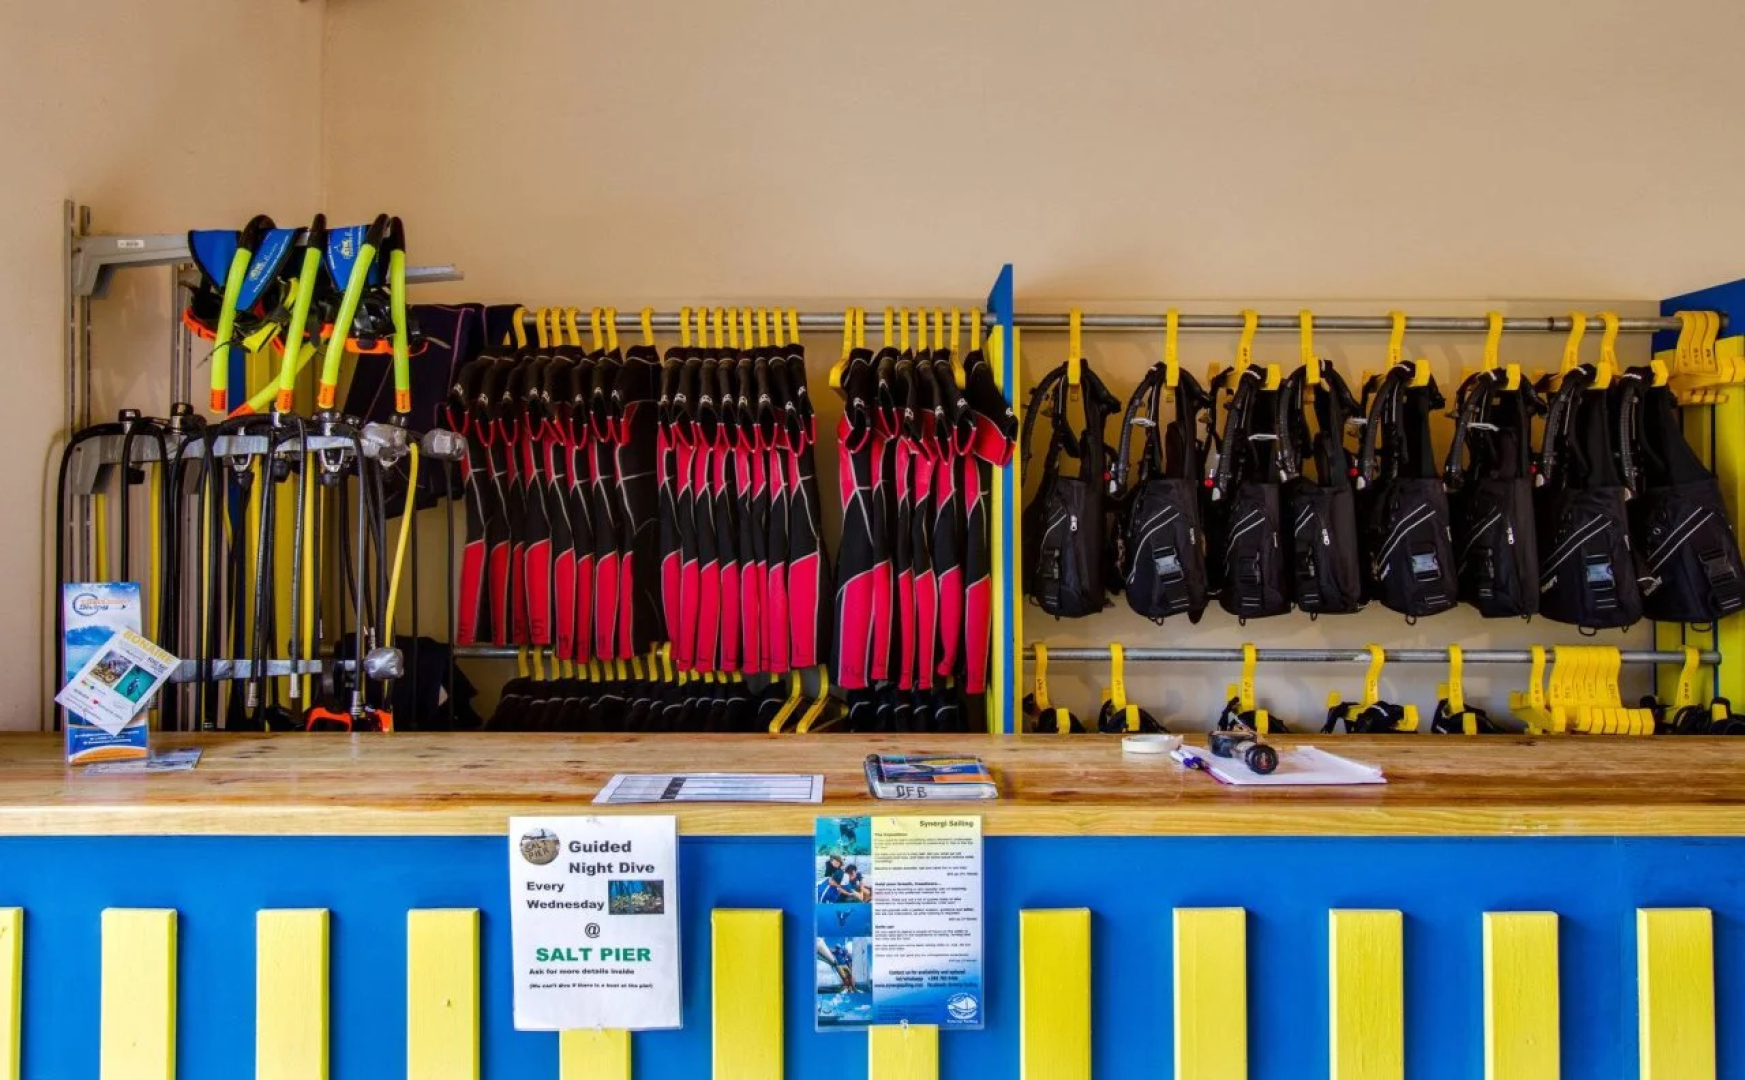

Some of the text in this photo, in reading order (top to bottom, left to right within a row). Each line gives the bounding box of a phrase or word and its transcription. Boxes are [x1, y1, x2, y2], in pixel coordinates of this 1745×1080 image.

[919, 820, 974, 828] Synergi Sailing
[525, 840, 547, 853] SALT
[569, 840, 632, 853] Guided
[569, 862, 655, 876] Night Dive
[526, 881, 565, 893] Every
[527, 900, 605, 911] Wednesday
[584, 922, 601, 939] @
[535, 947, 652, 962] SALT PIER
